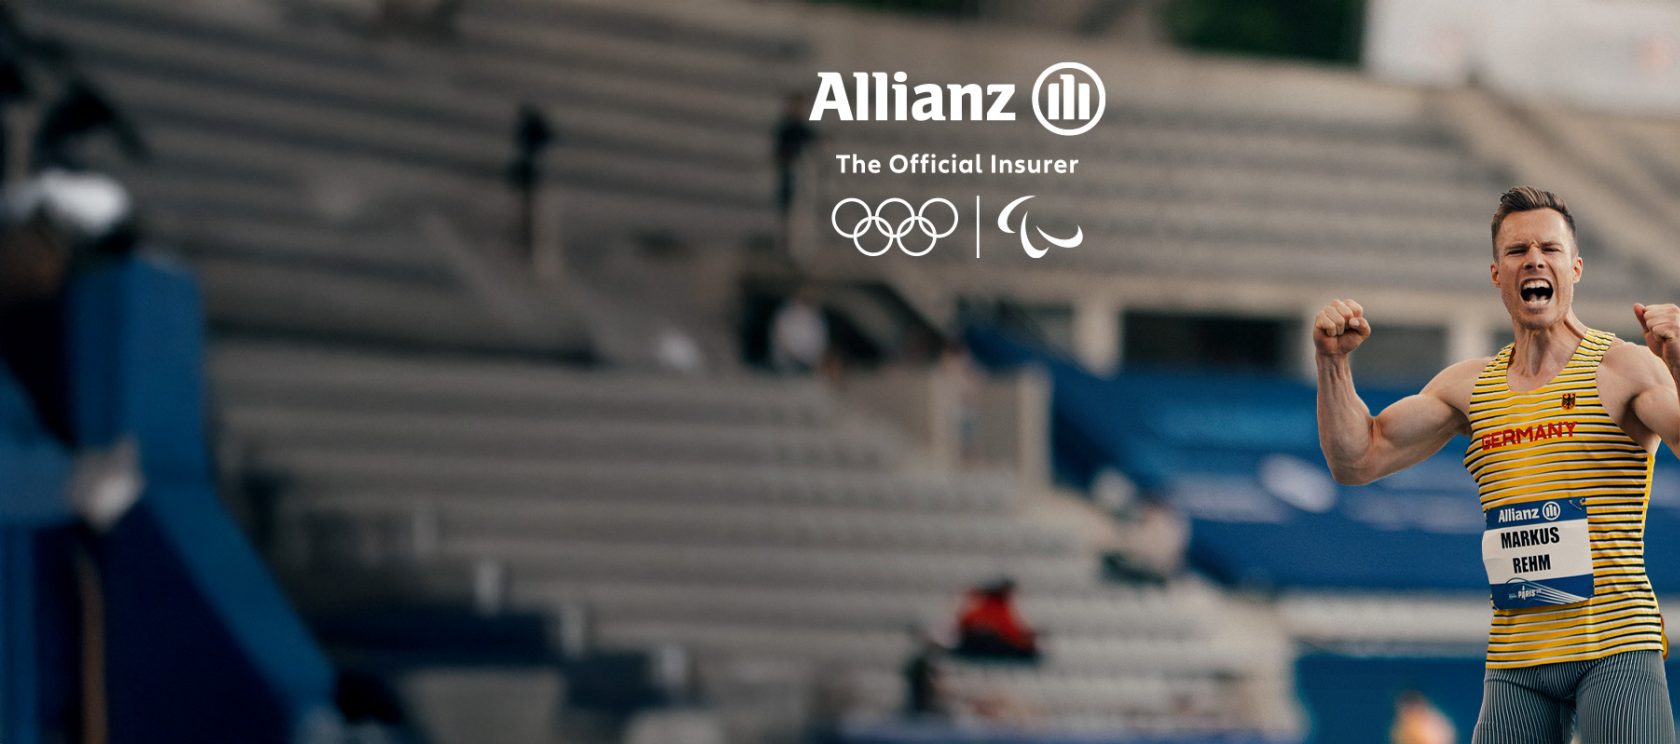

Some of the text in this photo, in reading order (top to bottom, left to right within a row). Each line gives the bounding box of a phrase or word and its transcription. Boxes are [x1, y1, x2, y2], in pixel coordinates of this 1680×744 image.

[1481, 421, 1578, 450] GERMANY
[1498, 508, 1540, 523] Allianz
[1501, 527, 1560, 549] MARKUS
[1512, 554, 1551, 574] REHM
